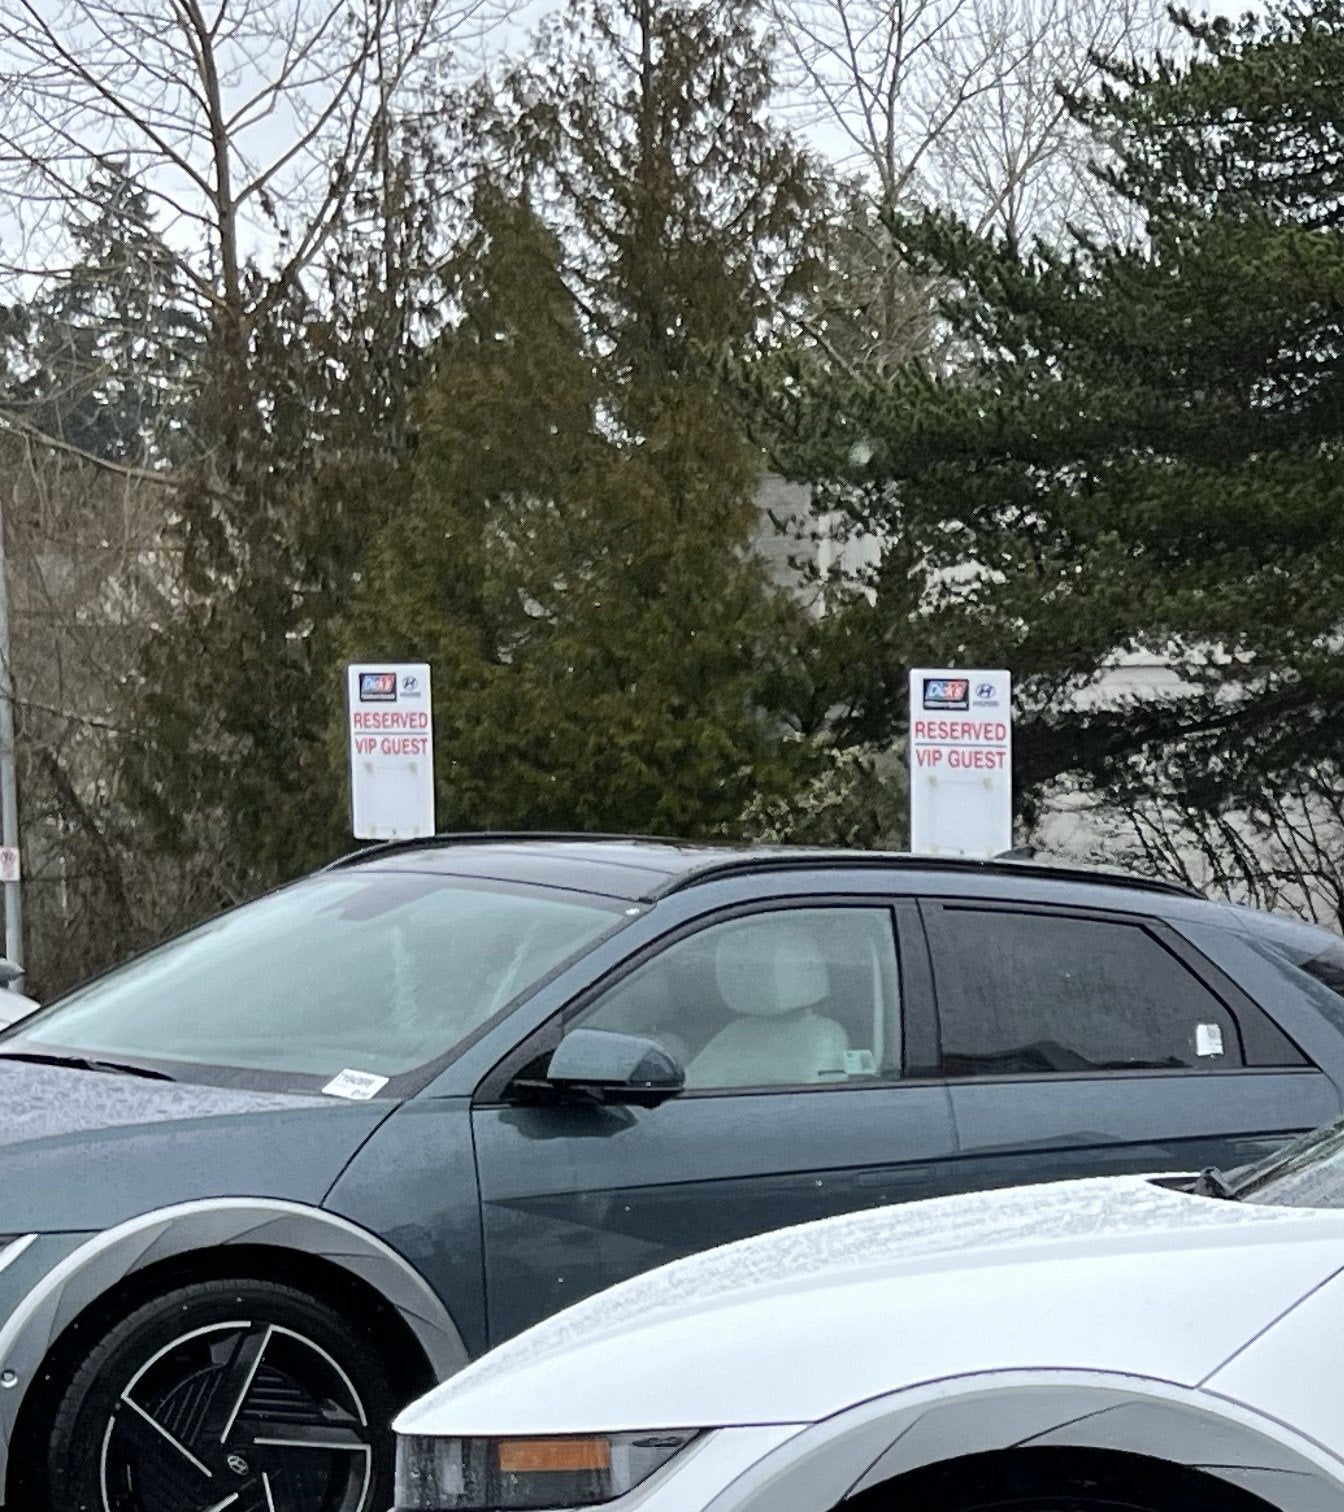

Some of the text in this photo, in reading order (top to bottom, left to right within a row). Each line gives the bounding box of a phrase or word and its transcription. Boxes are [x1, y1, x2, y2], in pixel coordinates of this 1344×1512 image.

[353, 712, 428, 729] RESERVED
[914, 721, 1007, 741] RESERVED
[355, 738, 428, 755] VIP GUEST
[916, 749, 1007, 769] VIP GUEST
